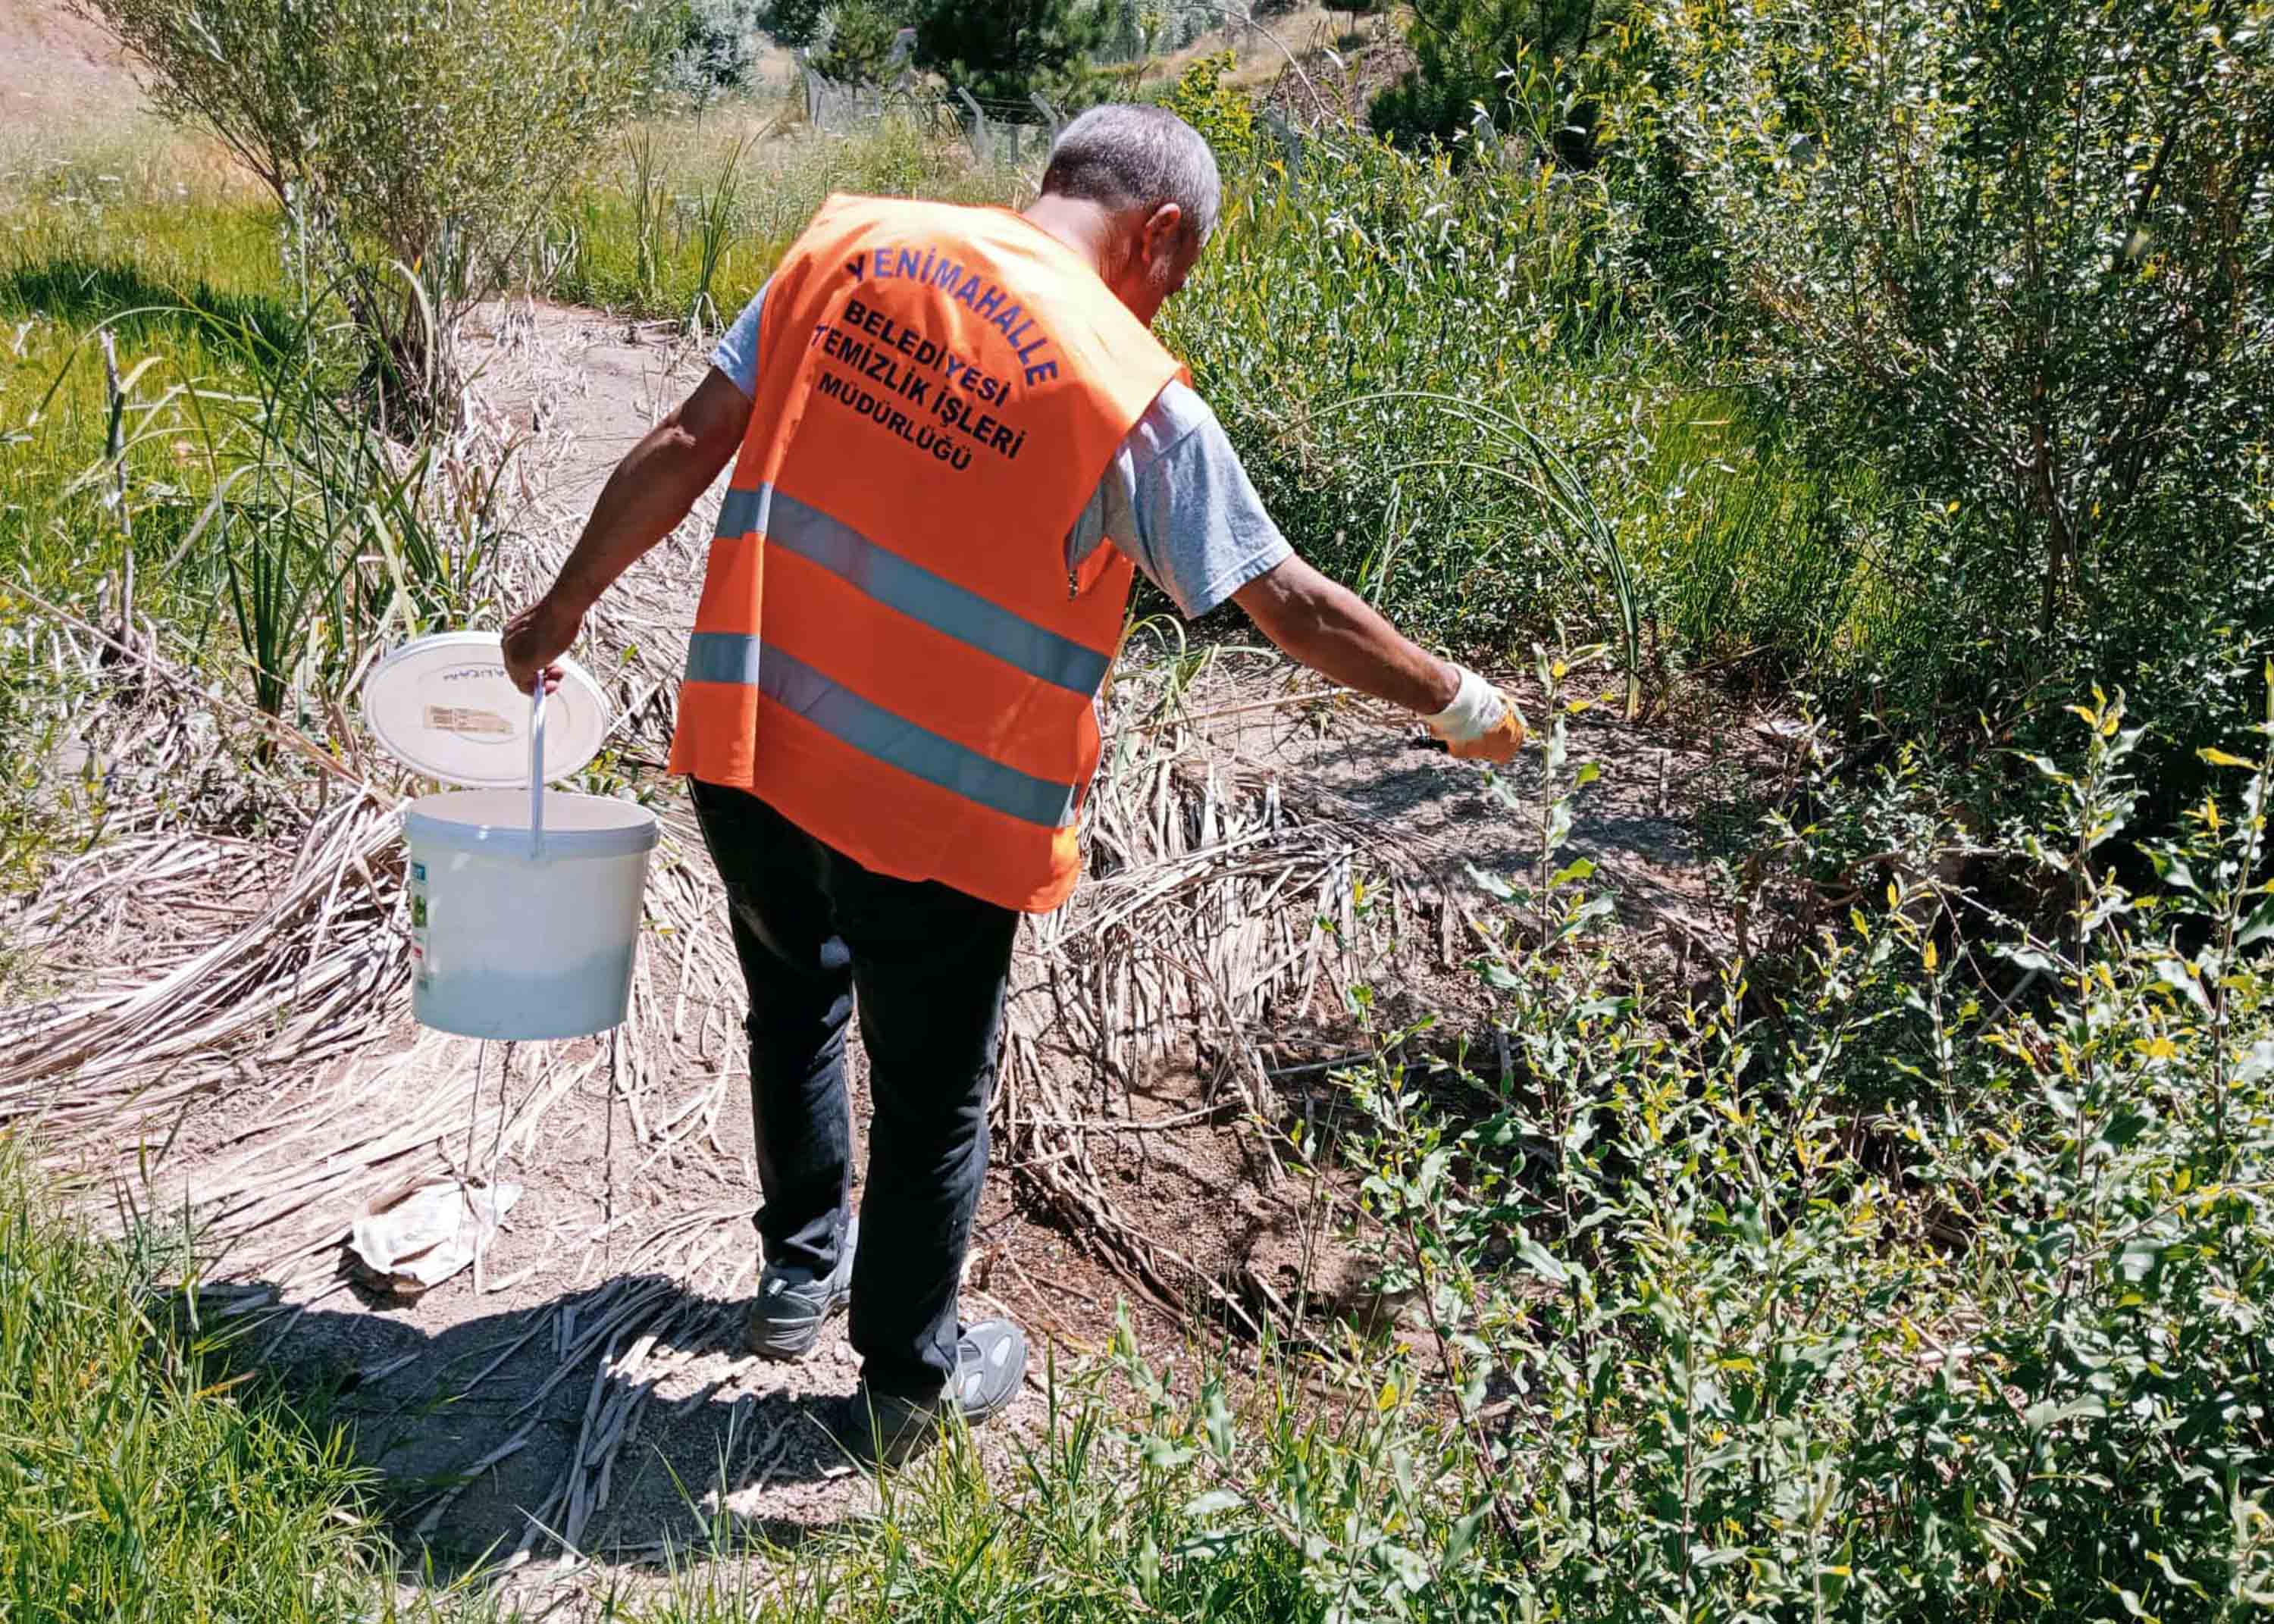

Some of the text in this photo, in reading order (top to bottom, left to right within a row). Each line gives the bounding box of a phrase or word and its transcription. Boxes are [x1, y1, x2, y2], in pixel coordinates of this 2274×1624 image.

[843, 300, 1010, 407] BELEDİYESİ
[846, 249, 1057, 386] YENİMAHALLE
[812, 325, 1028, 458] TEMİZLİK İŞLERİ
[819, 372, 972, 471] MÜDÜRLÜĞÜ
